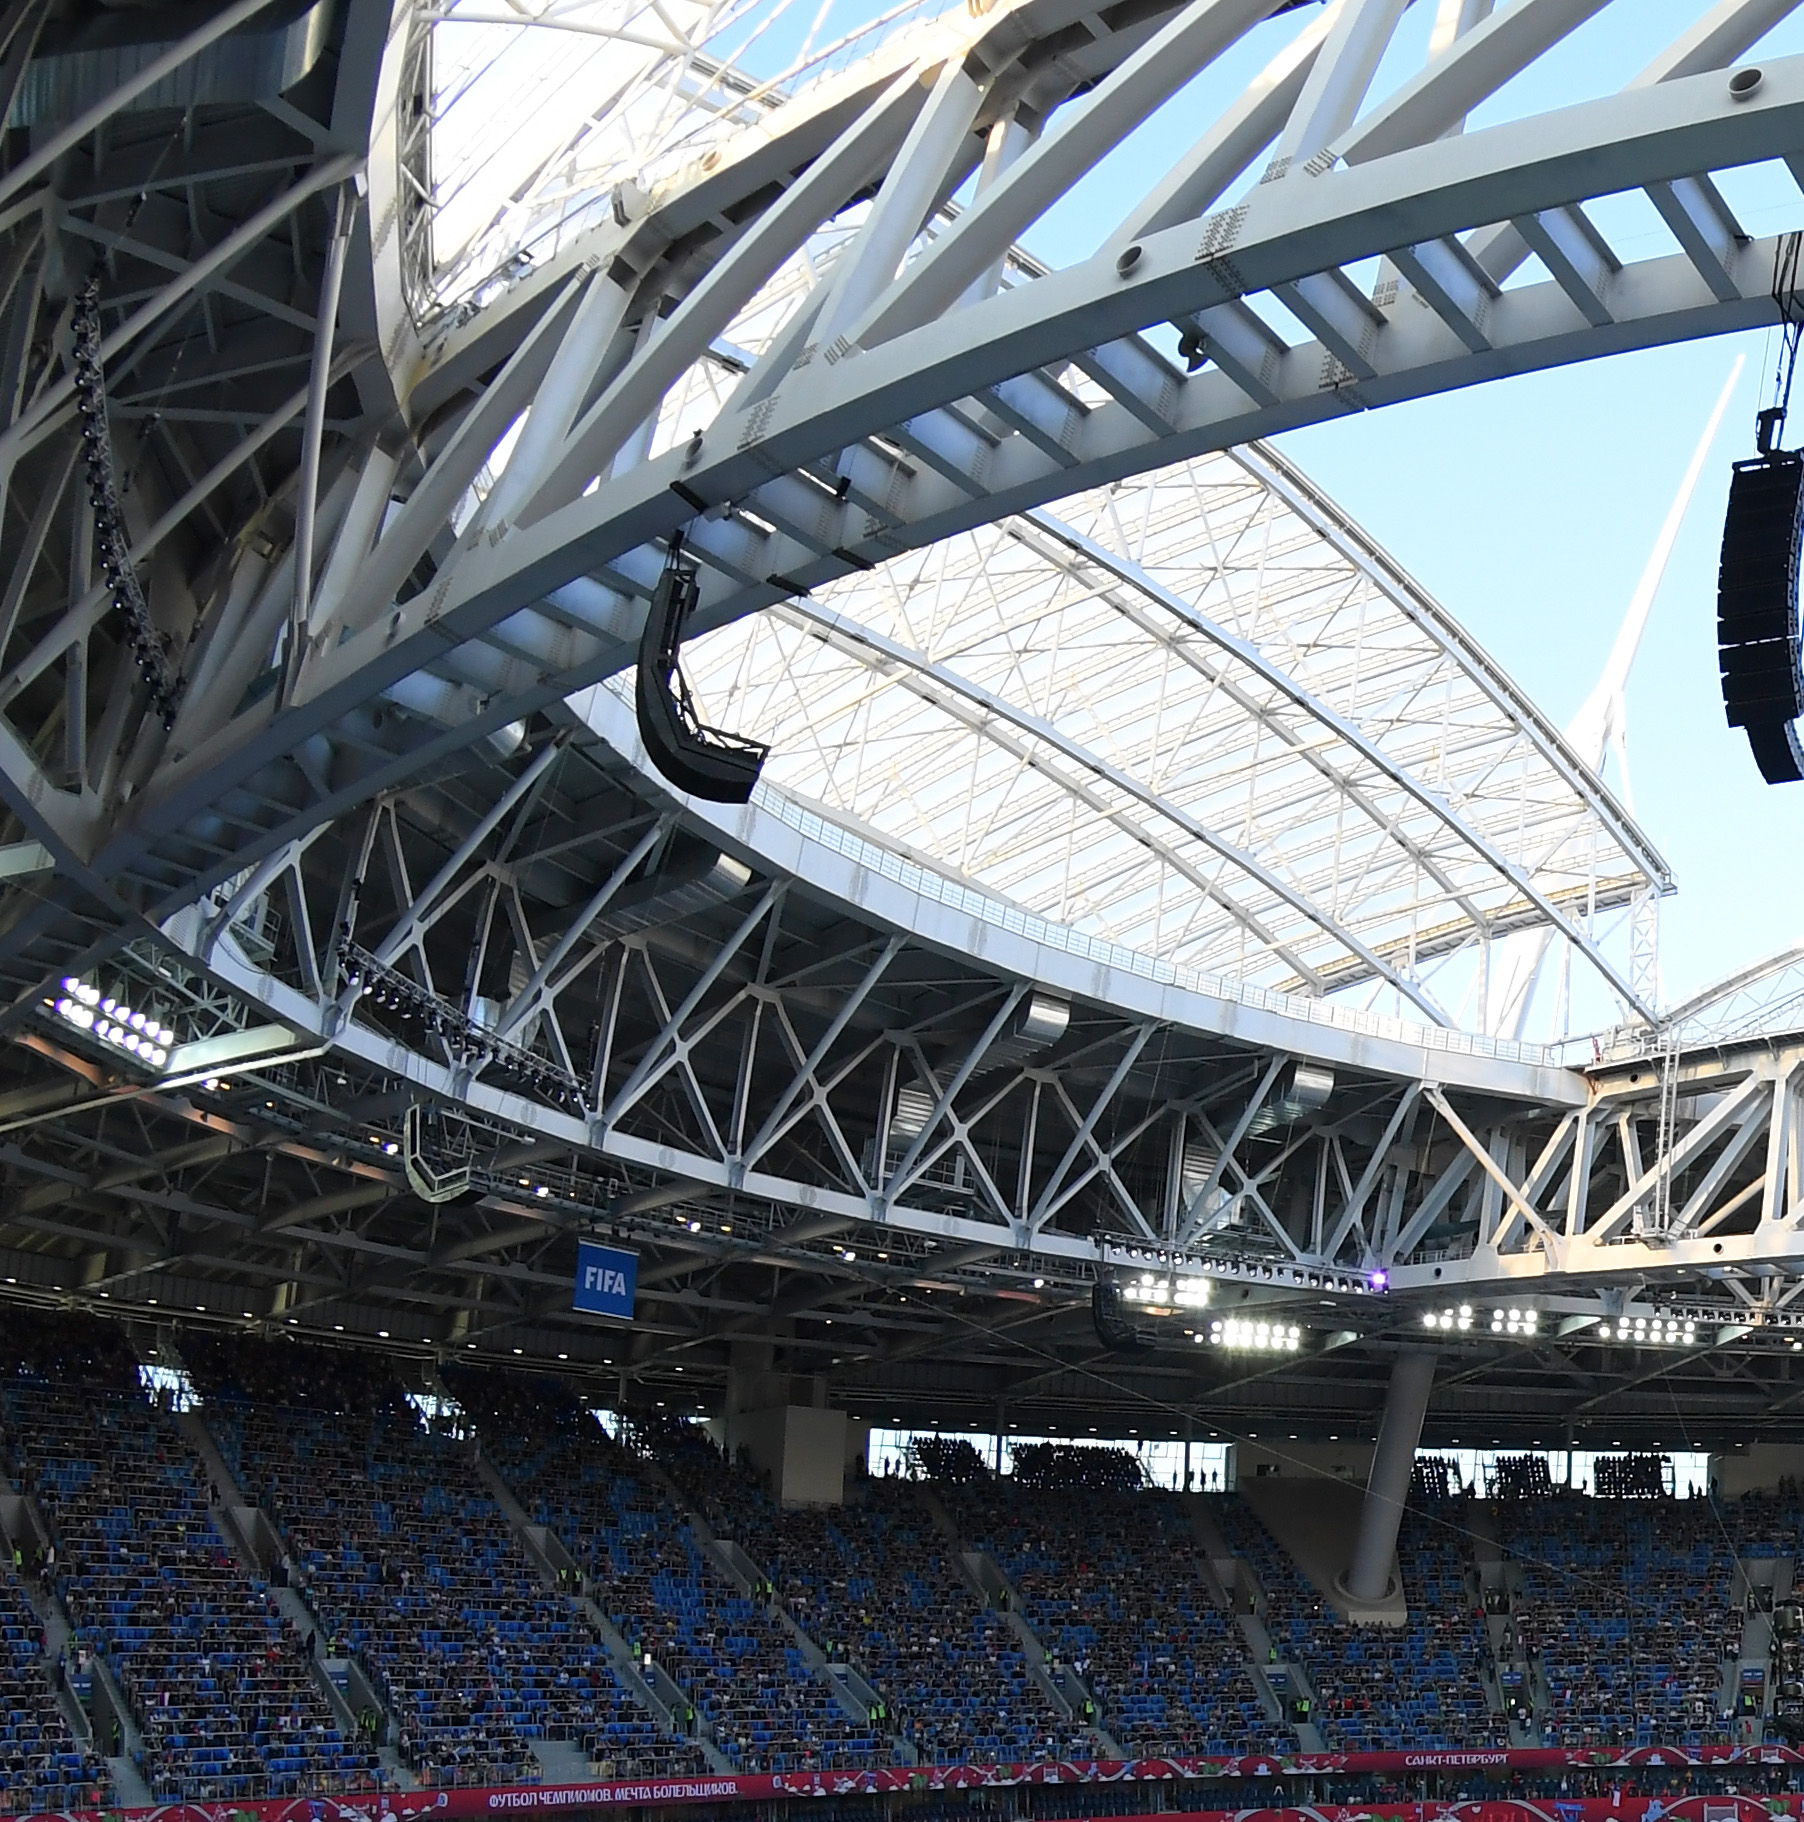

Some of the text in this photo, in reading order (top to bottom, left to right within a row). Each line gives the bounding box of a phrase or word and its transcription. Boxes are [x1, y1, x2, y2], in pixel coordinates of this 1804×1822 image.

[584, 1266, 627, 1296] FIFA
[1405, 1753, 1509, 1766] САНКТ-ПЕТЕРБУРГ
[489, 1791, 539, 1808] ФУТБОЛ
[615, 1786, 651, 1801] МЕЧТА
